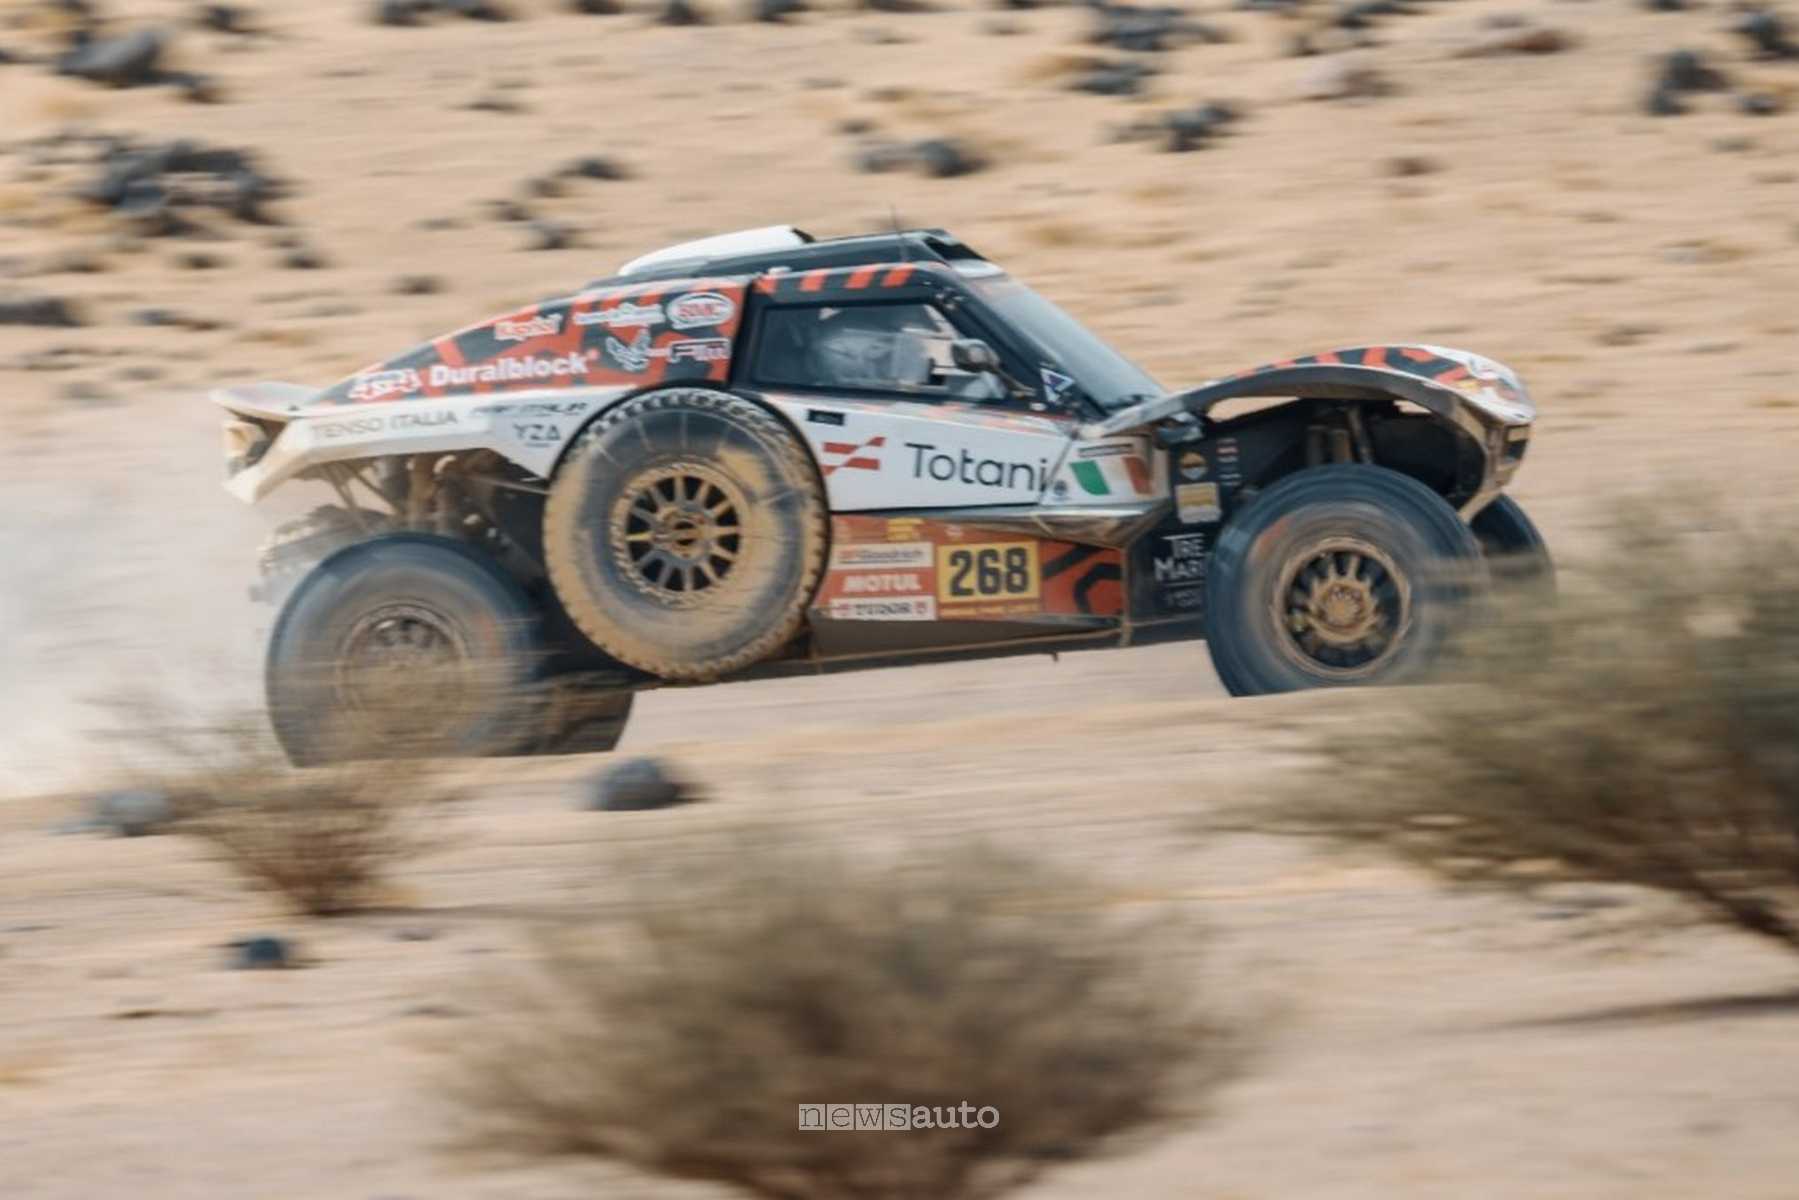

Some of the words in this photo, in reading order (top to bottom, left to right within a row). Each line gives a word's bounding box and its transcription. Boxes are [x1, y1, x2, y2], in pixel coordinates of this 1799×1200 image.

[429, 352, 588, 387] Duralblock
[390, 410, 459, 429] ITALIA
[904, 442, 1049, 493] Totani
[842, 573, 922, 593] MOTUL
[950, 546, 1029, 597] 268
